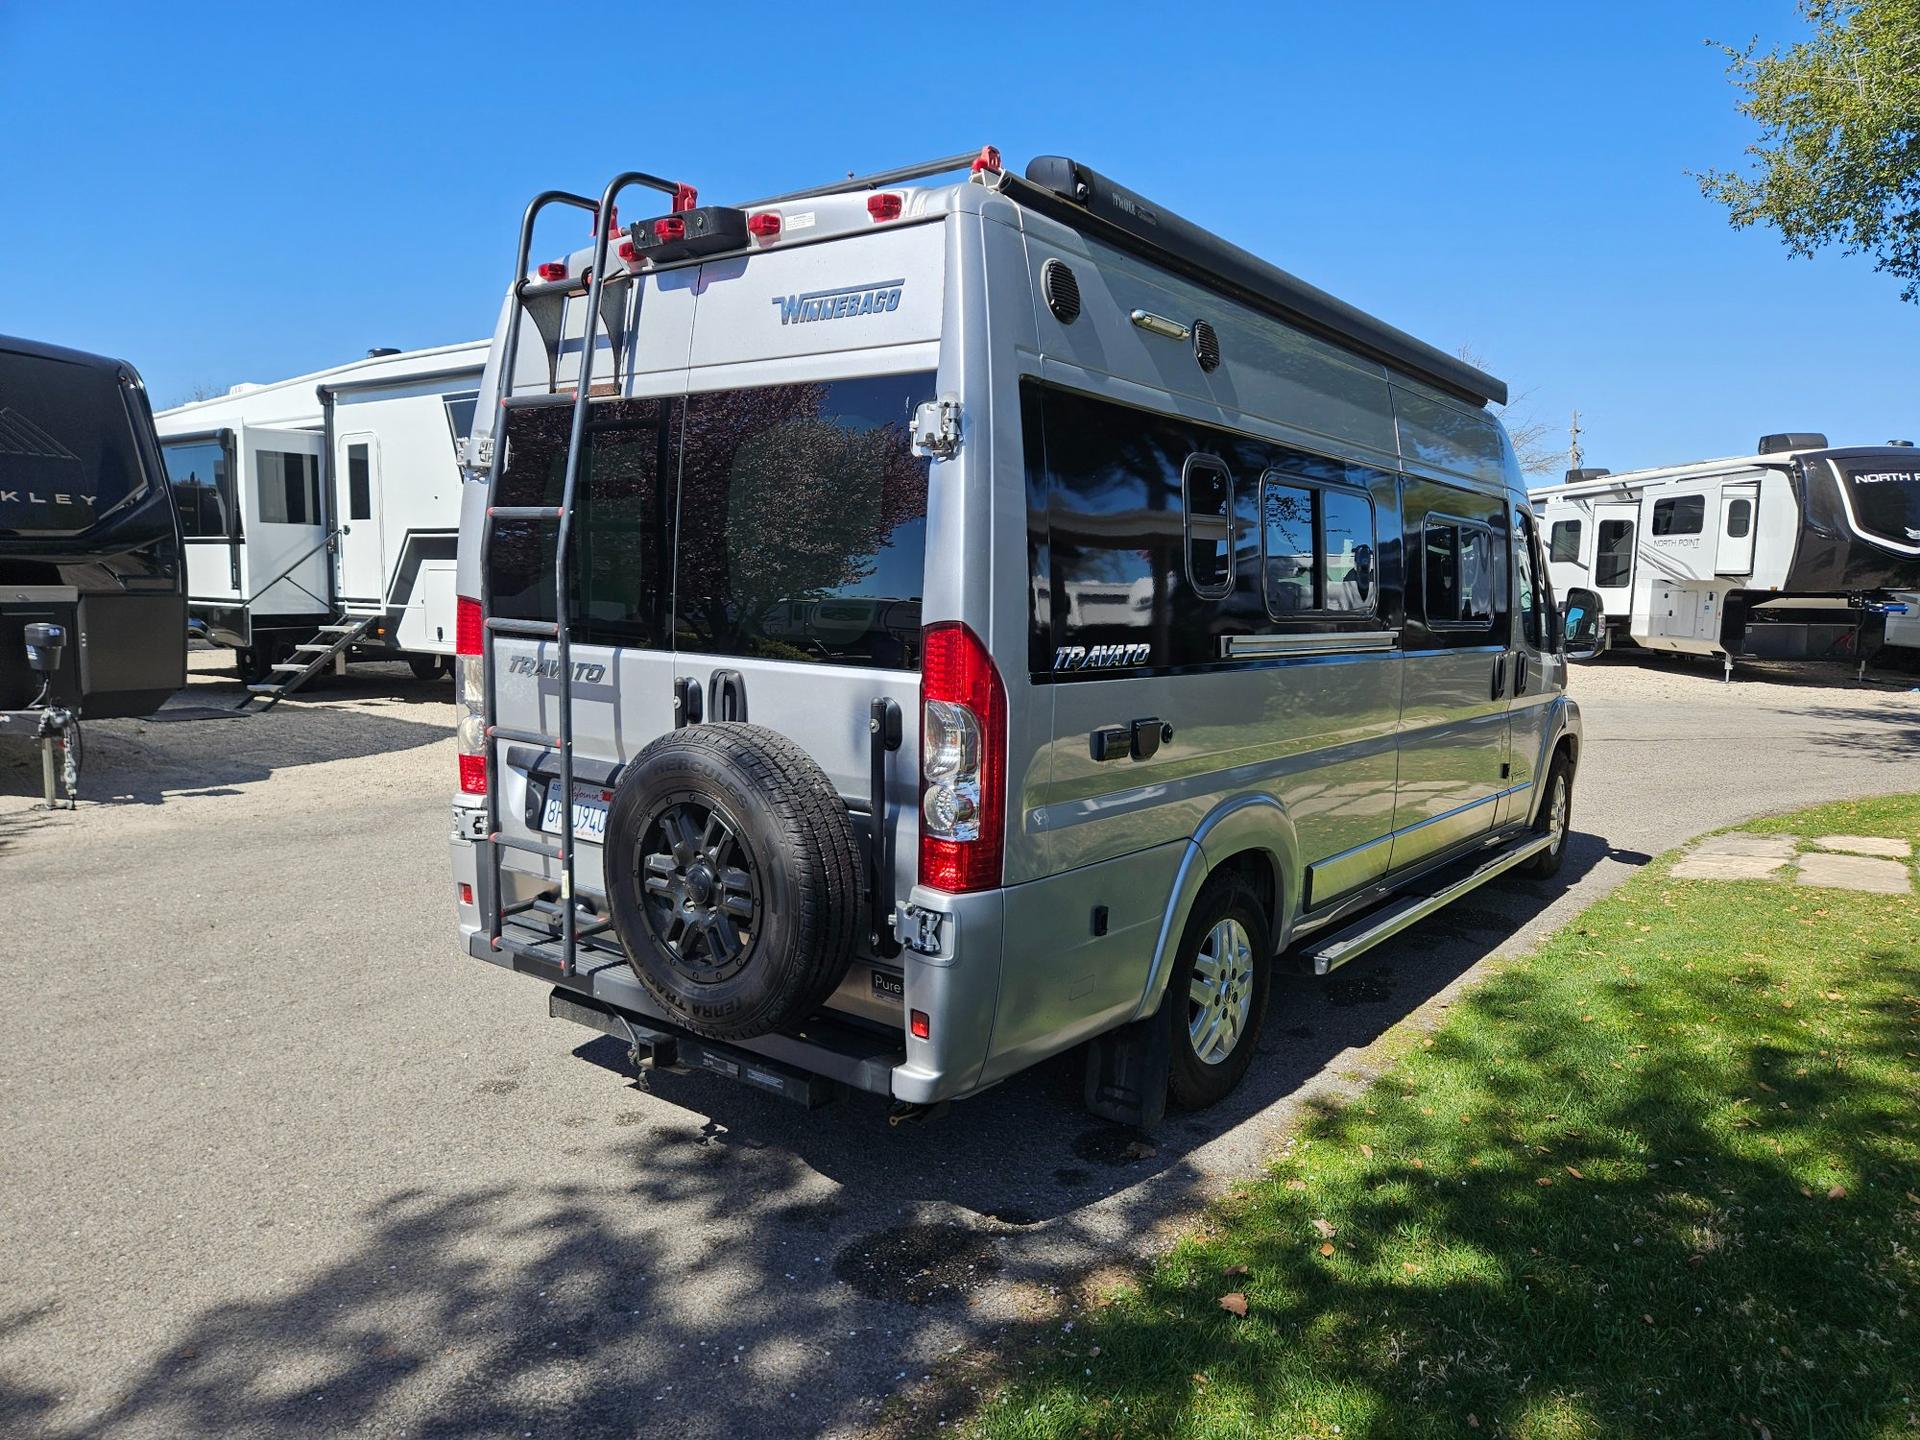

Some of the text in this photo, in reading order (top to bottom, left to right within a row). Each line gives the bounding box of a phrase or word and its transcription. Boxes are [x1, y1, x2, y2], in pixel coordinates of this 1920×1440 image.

[772, 279, 905, 325] WINNEBAGO
[1854, 472, 1911, 484] NORTH
[1653, 538, 1701, 547] NORTH POINT
[1053, 643, 1151, 671] TRAVATO
[653, 757, 749, 810] HERCULES
[875, 974, 901, 993] Pure
[693, 997, 742, 1019] TERRA
